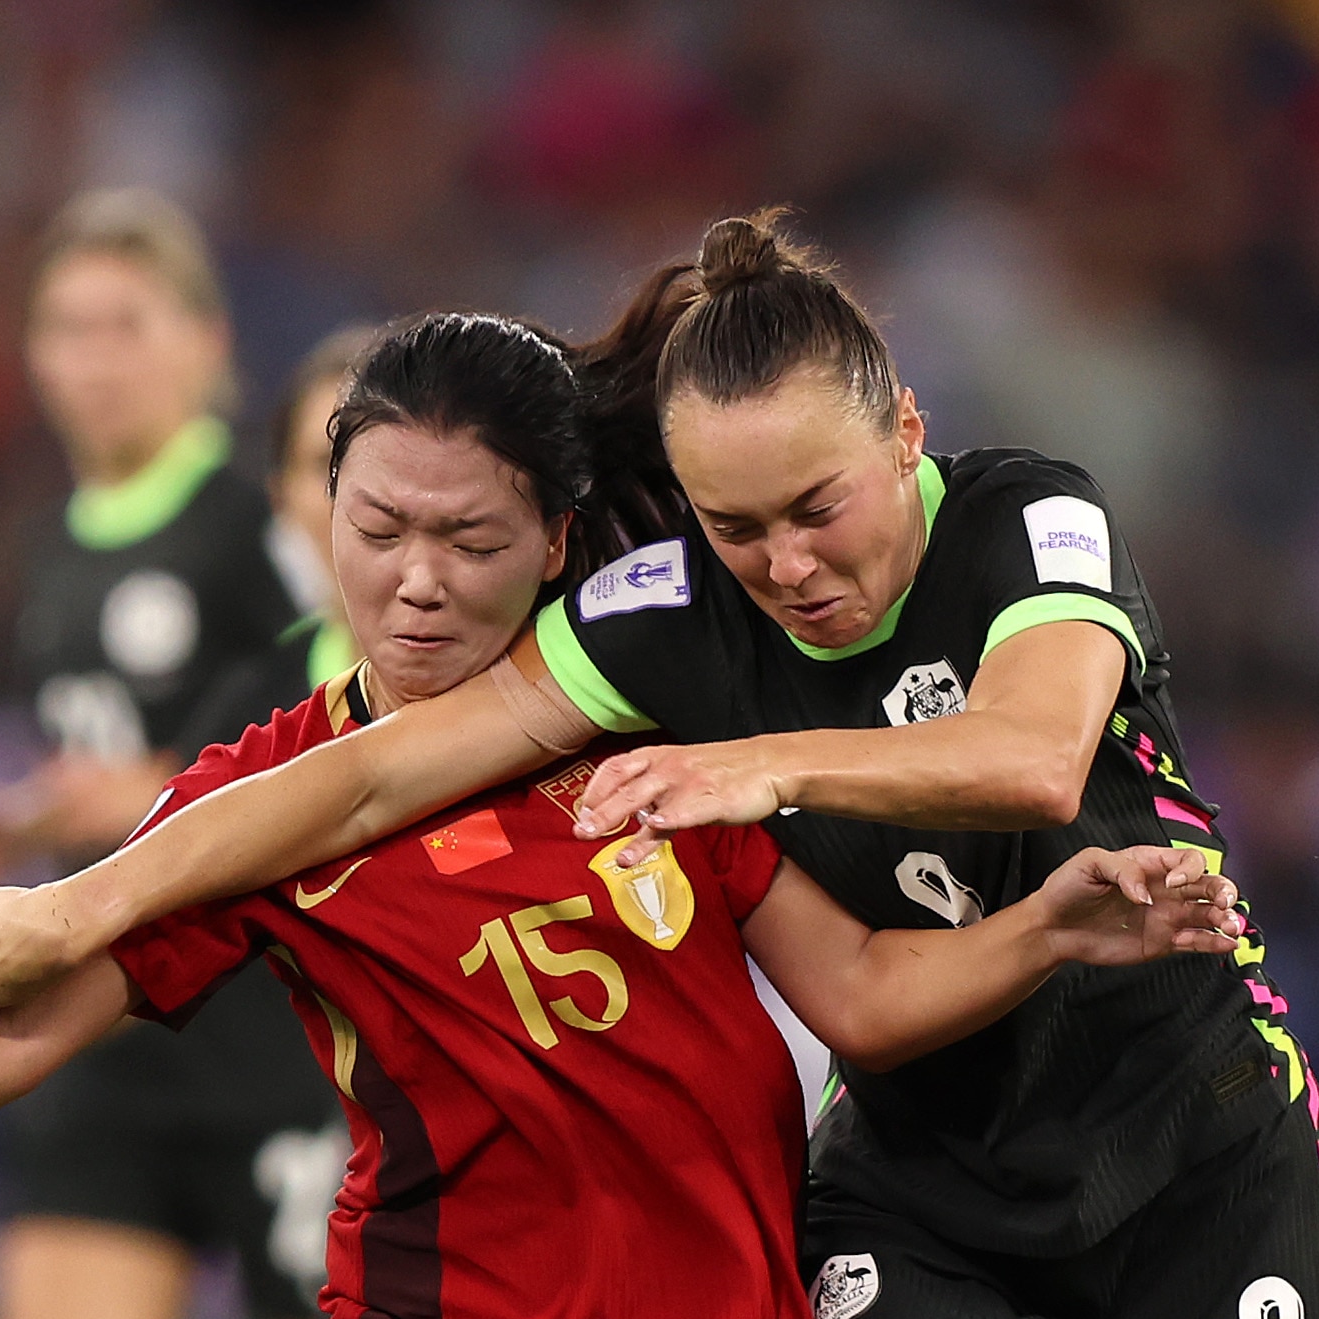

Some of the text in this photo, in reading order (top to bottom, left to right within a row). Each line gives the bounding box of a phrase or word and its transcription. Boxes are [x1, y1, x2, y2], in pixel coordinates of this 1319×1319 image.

[1047, 531, 1098, 547] DREAM
[544, 766, 592, 796] CFA
[458, 894, 629, 1050] 15
